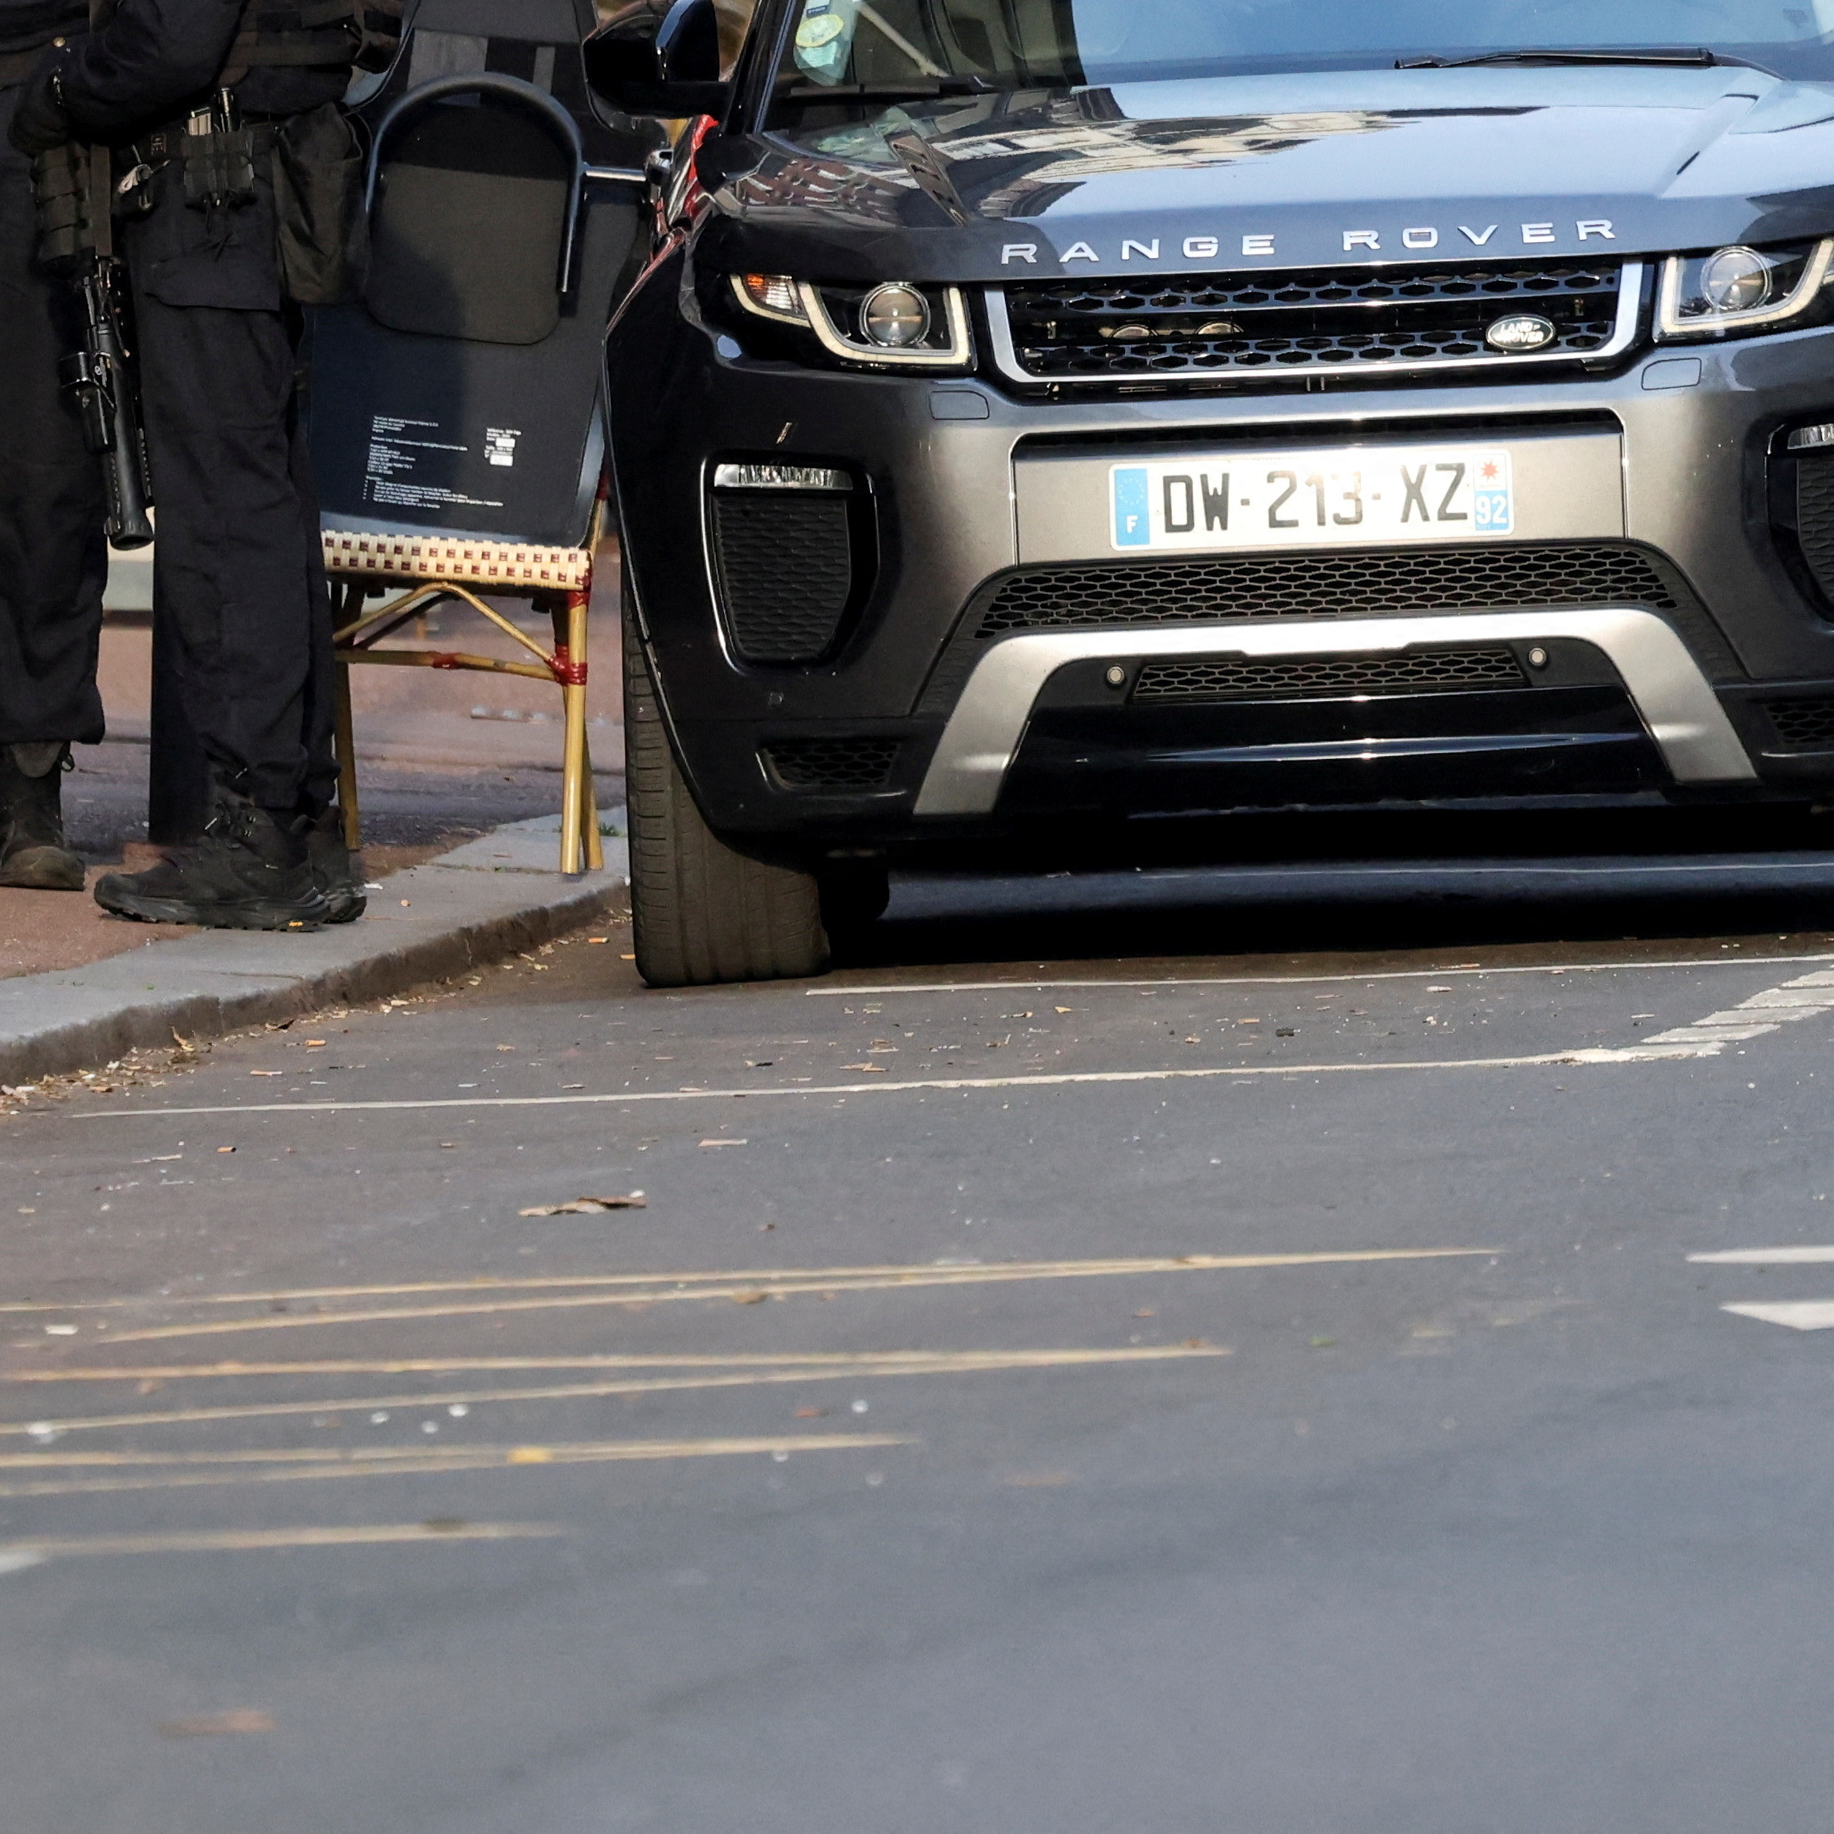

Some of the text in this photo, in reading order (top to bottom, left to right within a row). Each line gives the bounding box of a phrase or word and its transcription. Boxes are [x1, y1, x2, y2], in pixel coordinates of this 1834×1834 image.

[1000, 216, 1618, 268] RANGE ROVER
[1500, 321, 1533, 334] LAND
[1125, 515, 1138, 534] F
[1476, 495, 1508, 525] 92
